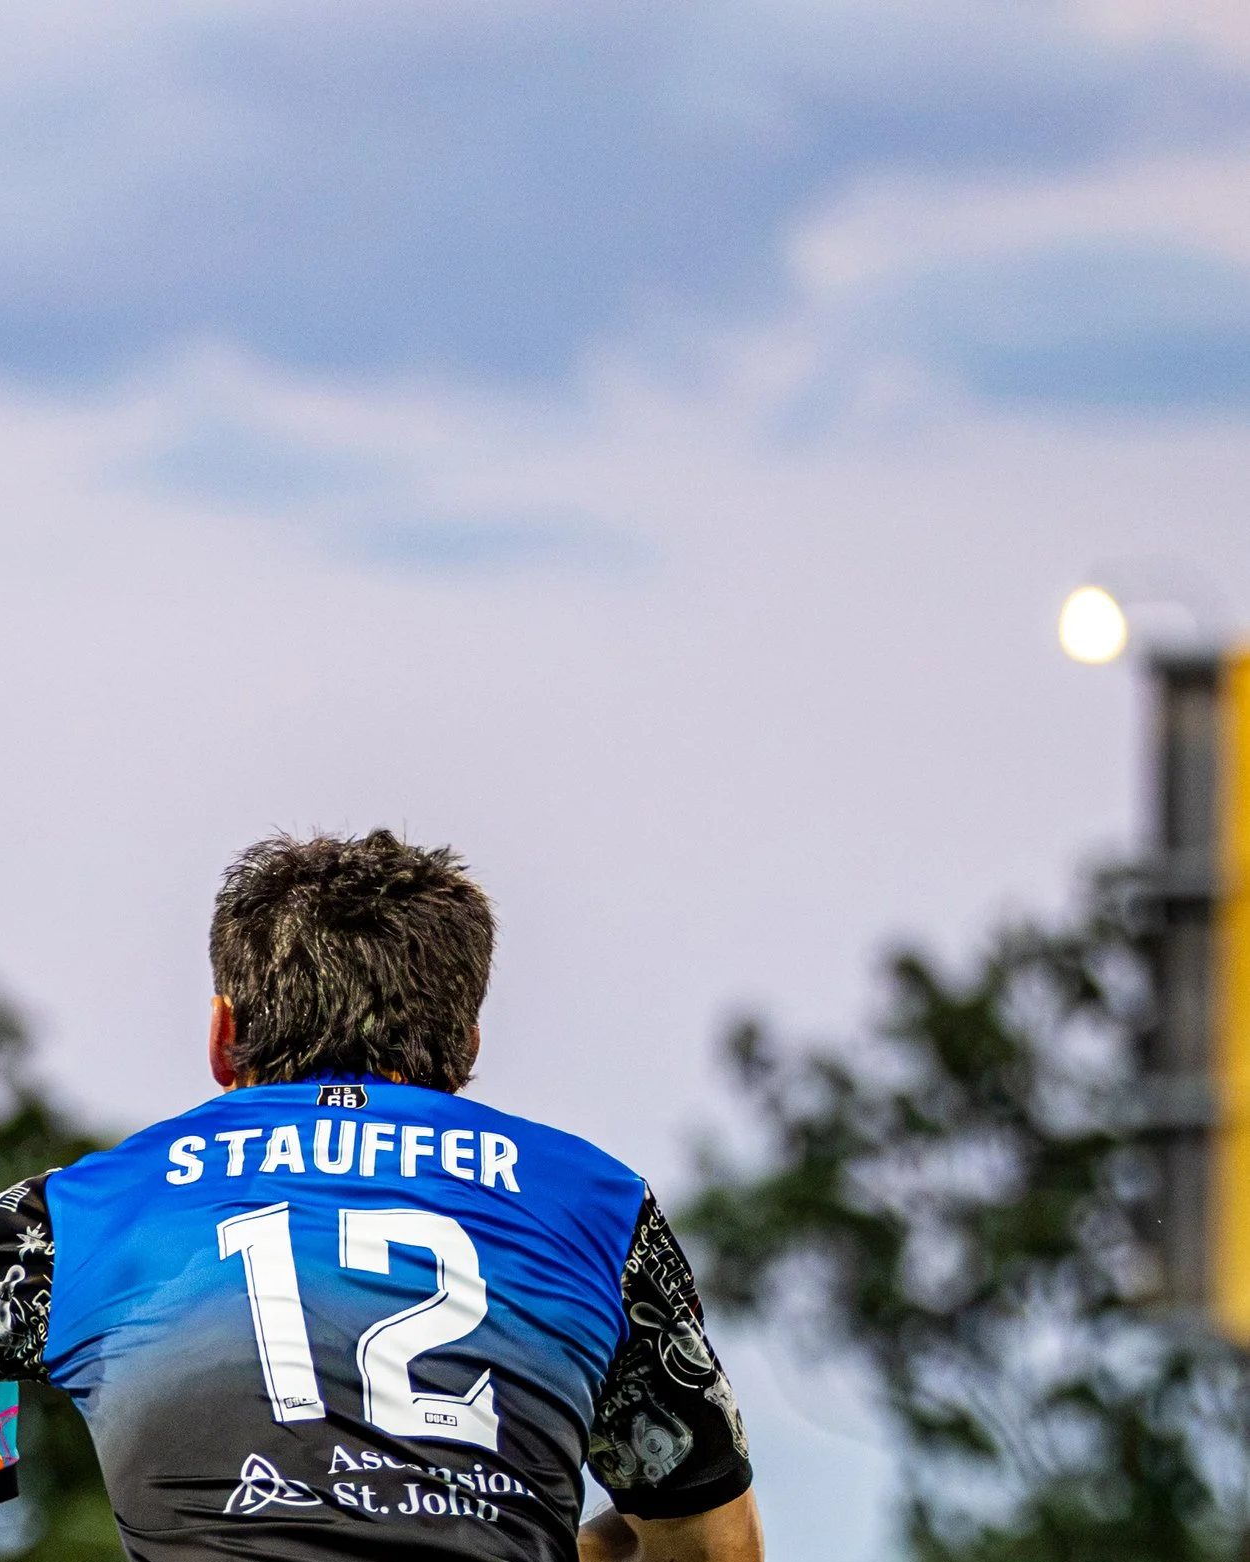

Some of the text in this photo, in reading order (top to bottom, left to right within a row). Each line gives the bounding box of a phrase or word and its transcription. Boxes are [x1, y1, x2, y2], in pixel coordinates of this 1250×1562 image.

[327, 1094, 357, 1109] 66
[333, 1087, 351, 1095] US
[166, 1119, 521, 1193] STAUFFER
[216, 1201, 499, 1451] 12
[327, 1445, 536, 1499] Asnsion
[332, 1482, 499, 1523] St. John
